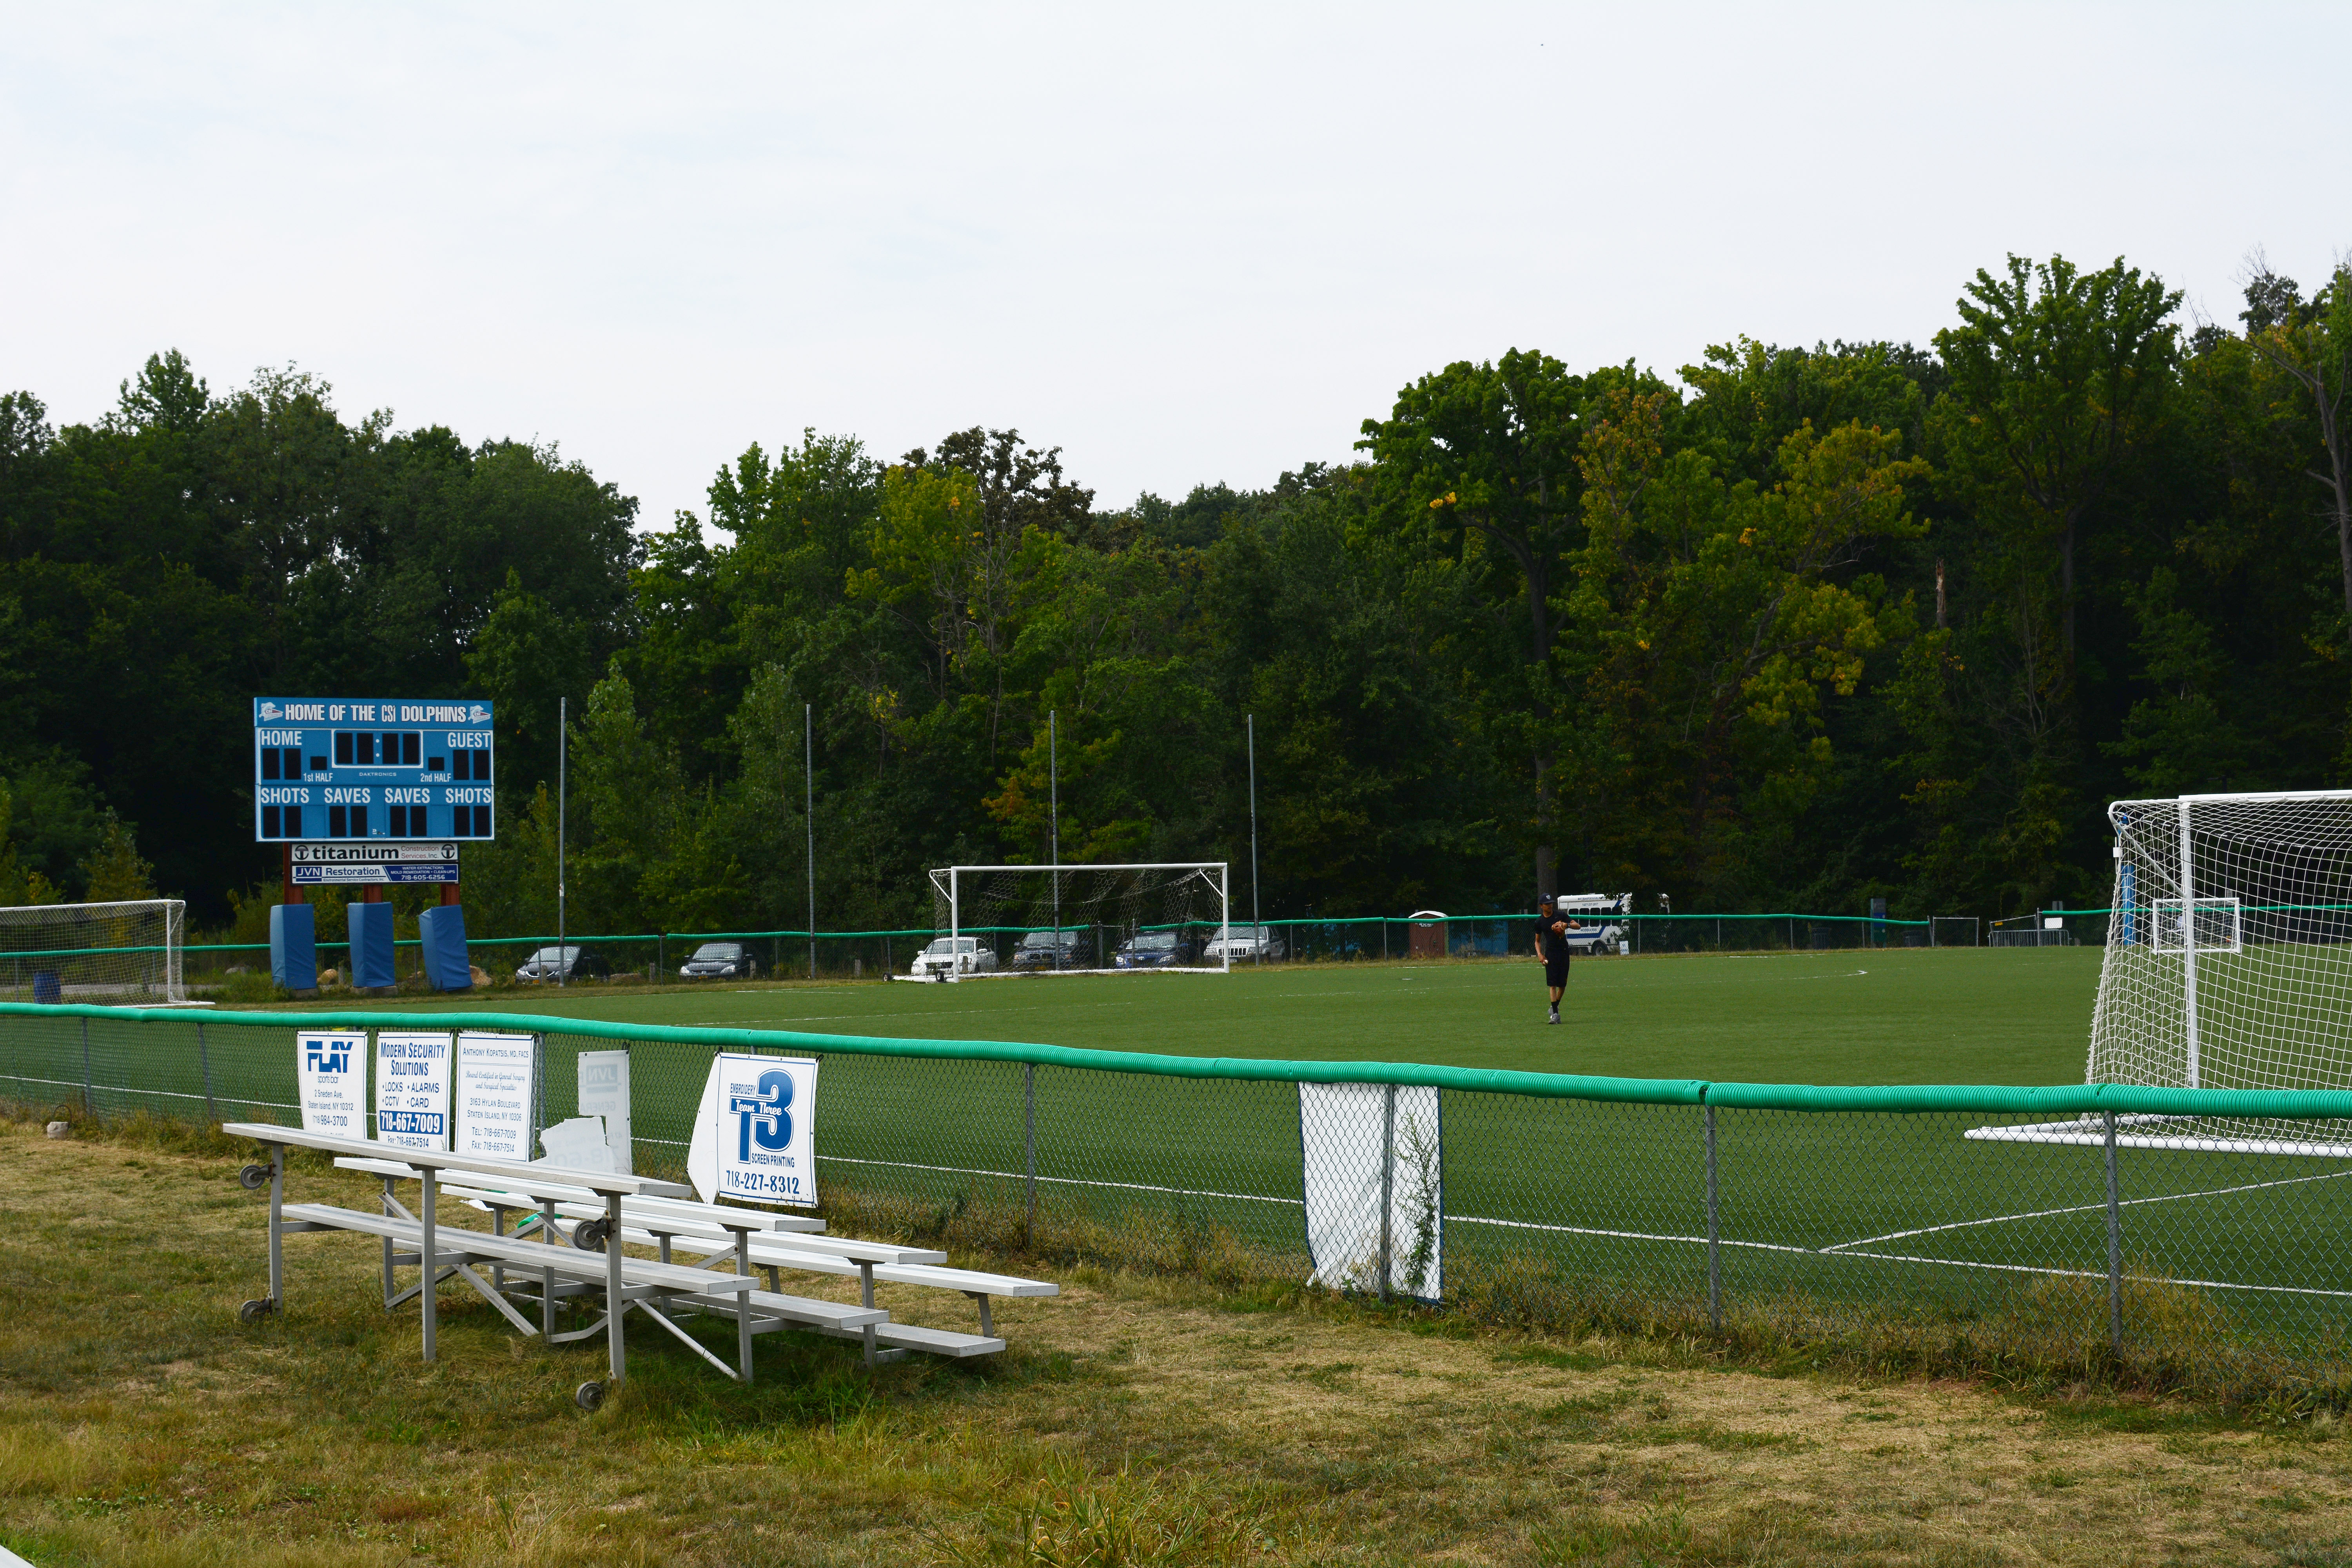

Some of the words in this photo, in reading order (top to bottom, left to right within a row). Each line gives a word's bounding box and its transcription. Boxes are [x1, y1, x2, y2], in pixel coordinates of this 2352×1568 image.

[285, 704, 325, 720] HOME
[329, 704, 346, 721] OF
[350, 705, 376, 721] THE
[401, 706, 466, 722] DOLPHINS
[261, 731, 302, 746] HOME
[448, 732, 490, 748] GUEST
[303, 773, 314, 782] 1st
[316, 773, 333, 782] HALF
[421, 773, 432, 782] 2nd
[434, 773, 451, 782] HALF
[261, 788, 309, 803] SHOTS
[325, 788, 371, 803] SAVES
[385, 788, 430, 803] SAVES
[446, 788, 492, 803] SHOTS
[312, 845, 399, 860] titanium
[298, 867, 320, 876] JVN
[326, 867, 380, 876] Restoration
[381, 1042, 407, 1058] MODERN
[408, 1042, 446, 1058] SECURITY
[463, 1047, 485, 1056] ANTHONY
[307, 1041, 354, 1073] PLAY
[391, 1059, 428, 1076] SOLUTIONS
[318, 1074, 330, 1085] sports
[330, 1074, 339, 1084] bar
[479, 1071, 494, 1081] Certified
[499, 1072, 512, 1082] General
[513, 1073, 525, 1083] Surgery
[385, 1082, 403, 1092] LOCKS
[411, 1082, 439, 1093] ALARMS
[730, 1083, 756, 1095] EMBROIDERY
[308, 1101, 318, 1109] Staten
[319, 1102, 332, 1111] Island,
[385, 1096, 399, 1106] CCTV
[410, 1097, 429, 1108] CARD
[470, 1098, 481, 1106] 3163
[482, 1098, 496, 1107] HYLAN
[497, 1099, 521, 1109] BOULEVARD
[735, 1100, 755, 1112] Team
[759, 1102, 782, 1116] Three
[467, 1110, 483, 1118] STATEN
[485, 1111, 501, 1121] ISLAND,
[509, 1113, 522, 1121] 10306
[381, 1112, 440, 1133] 718-667-7009
[472, 1127, 482, 1136] TEL:
[484, 1128, 516, 1139] 718-667-7009
[472, 1140, 482, 1149] FAX:
[483, 1142, 514, 1152] 718-667-7514
[751, 1153, 769, 1165] SCREEN
[770, 1155, 795, 1168] PRINTING
[726, 1170, 800, 1194] 718-227-8312
